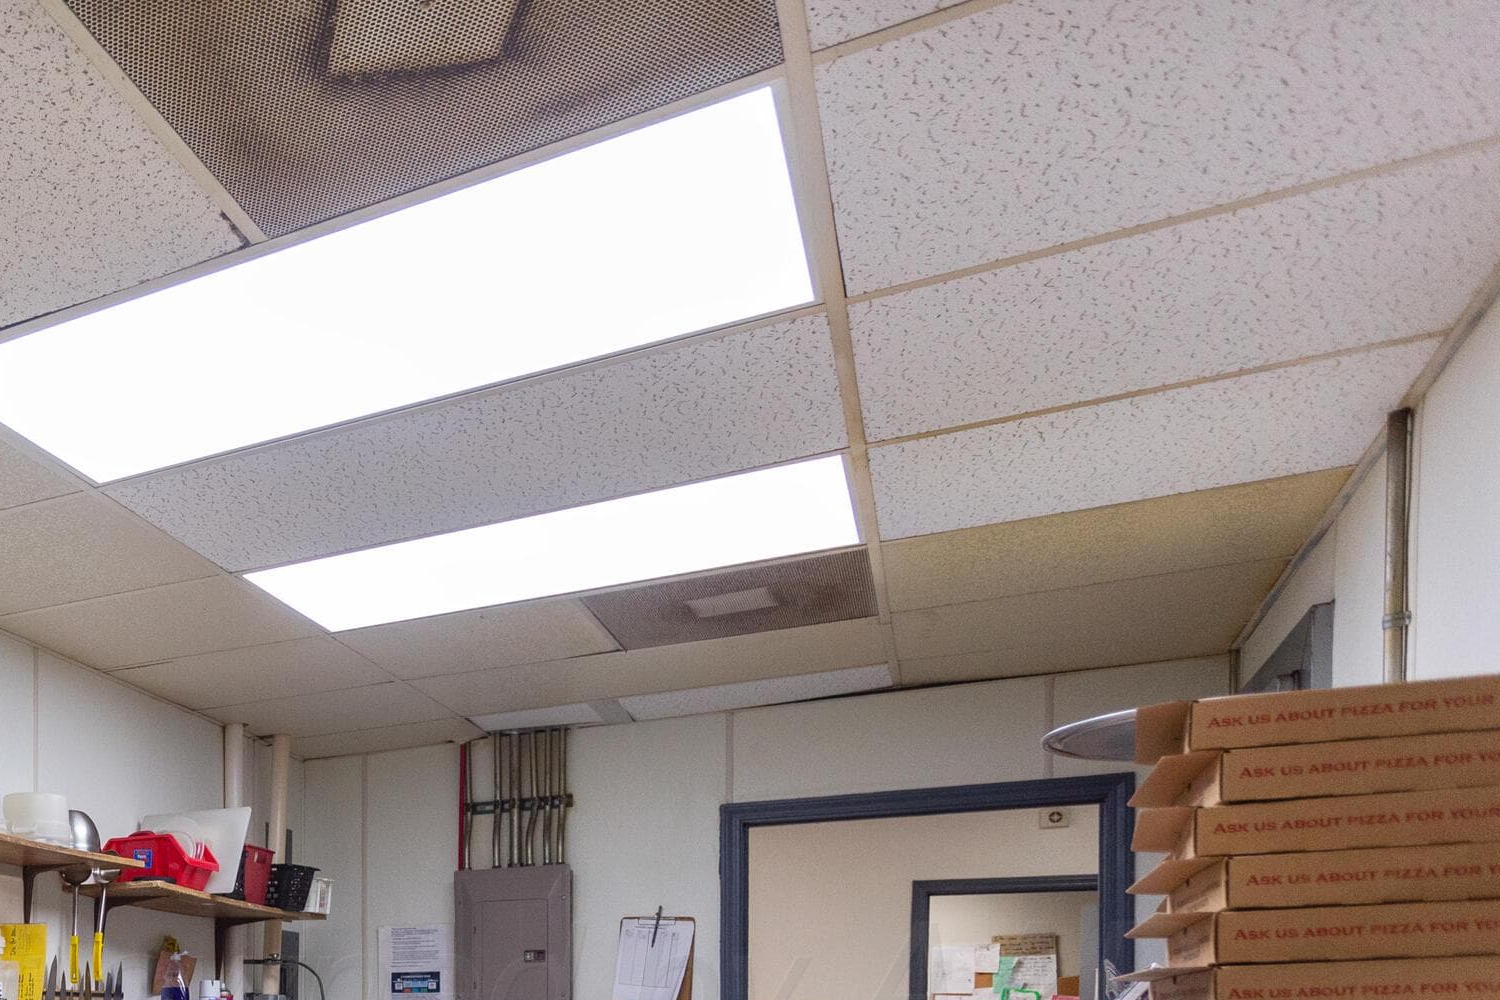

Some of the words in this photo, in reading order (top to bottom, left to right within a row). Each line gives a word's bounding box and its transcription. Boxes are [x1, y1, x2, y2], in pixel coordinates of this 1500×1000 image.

[1207, 717, 1243, 728] ASK
[1248, 714, 1271, 725] US
[1275, 708, 1335, 724] ABOUT
[1339, 703, 1393, 717] PIZZA
[1398, 699, 1437, 713] FOR
[1239, 766, 1275, 779] ASK
[1280, 765, 1304, 776] US
[1309, 760, 1367, 775] ABOUT
[1374, 755, 1427, 769] PIZZA
[1434, 752, 1471, 765] FOR
[1213, 823, 1249, 834] ASK
[1254, 821, 1277, 832] US
[1281, 817, 1343, 829] ABOUT
[1347, 813, 1399, 826] PIZZA
[1405, 811, 1444, 823] FOR
[1247, 874, 1283, 886] ASK
[1288, 874, 1311, 885] US
[1315, 871, 1378, 883] ABOUT
[1384, 867, 1437, 880] PIZZA
[1443, 865, 1482, 877] FOR
[1234, 928, 1269, 941] ASK
[1276, 928, 1299, 939] US
[1303, 925, 1365, 938] ABOUT
[1371, 922, 1424, 934] PIZZA
[1430, 920, 1468, 932] FOR
[1228, 987, 1263, 1000] ASK
[1269, 988, 1292, 999] US
[1298, 986, 1356, 998] ABOUT
[1361, 983, 1415, 996] PIZZA
[1420, 982, 1458, 994] FOR
